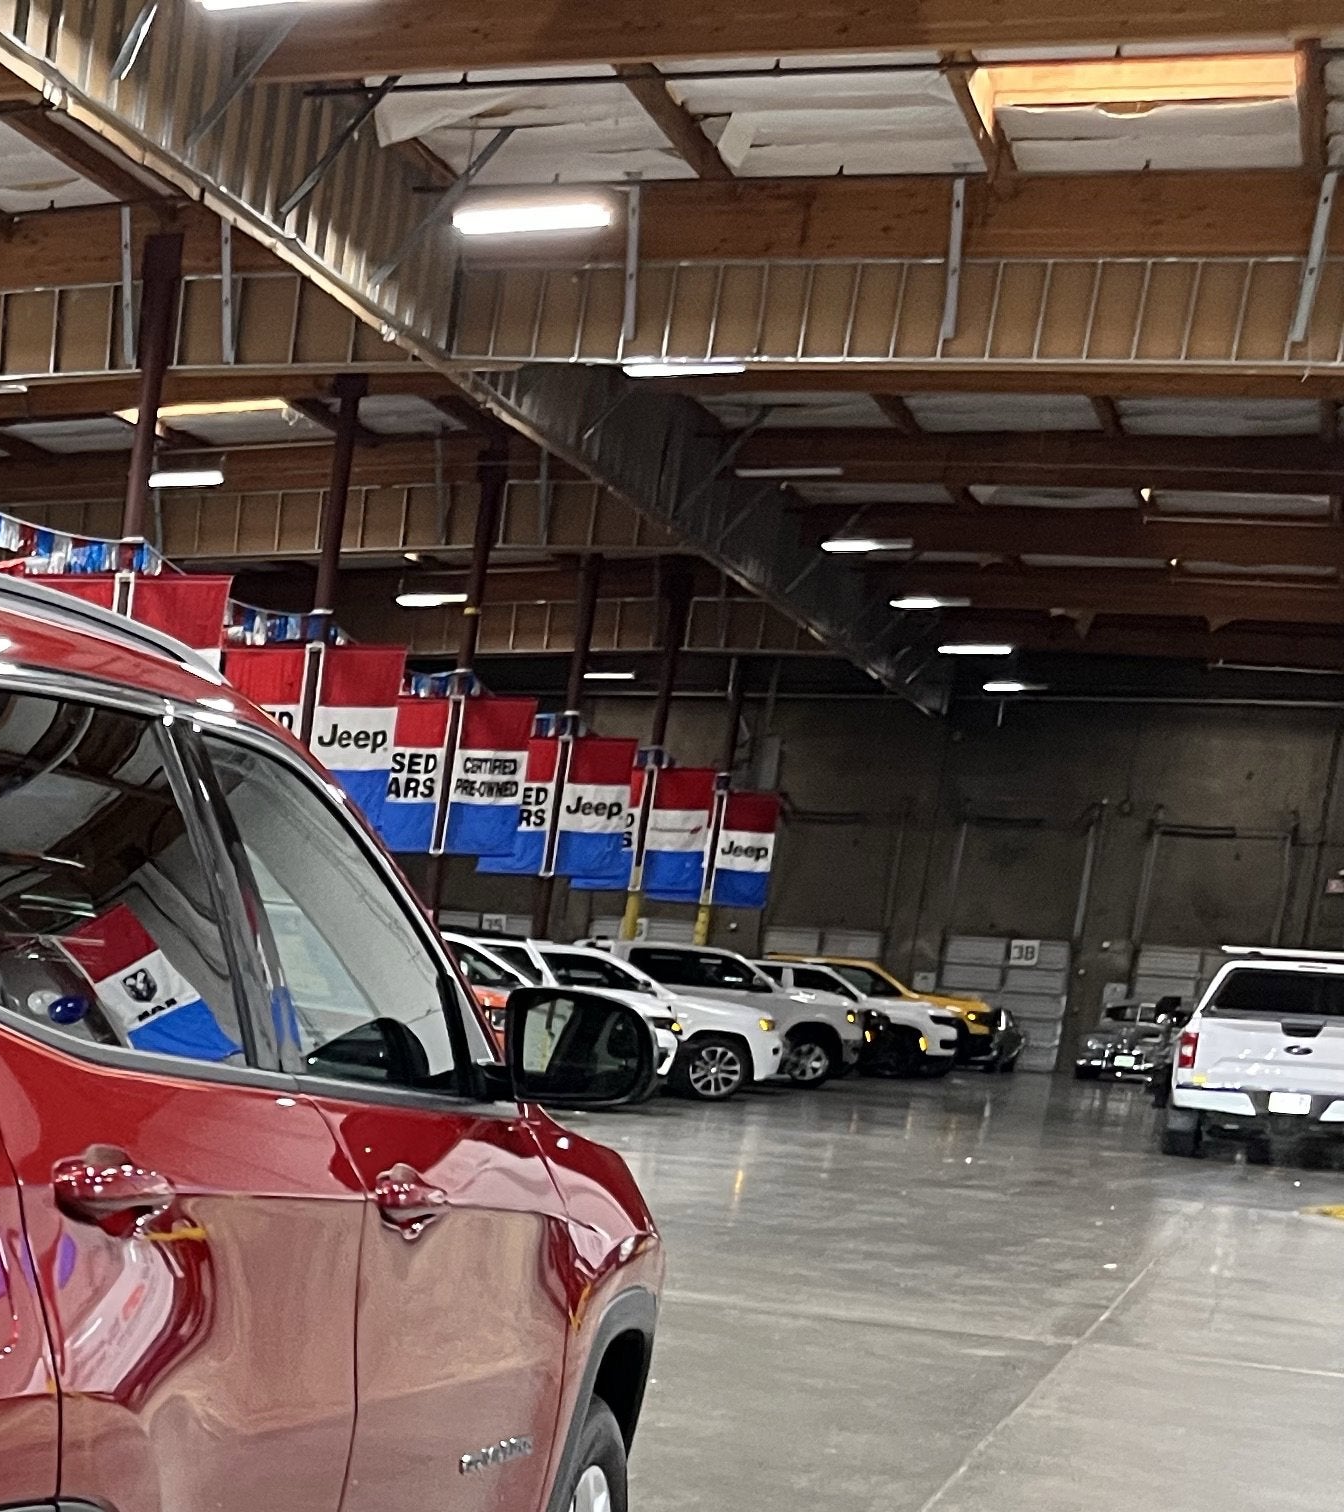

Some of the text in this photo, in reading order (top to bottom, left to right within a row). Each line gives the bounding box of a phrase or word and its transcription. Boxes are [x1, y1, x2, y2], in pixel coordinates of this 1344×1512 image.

[317, 723, 388, 753] Jeep
[392, 753, 438, 774] SED
[386, 777, 435, 798] ARS
[522, 787, 548, 806] ED
[518, 809, 546, 827] RS
[565, 796, 623, 820] Jeep
[721, 841, 769, 862] Jeep
